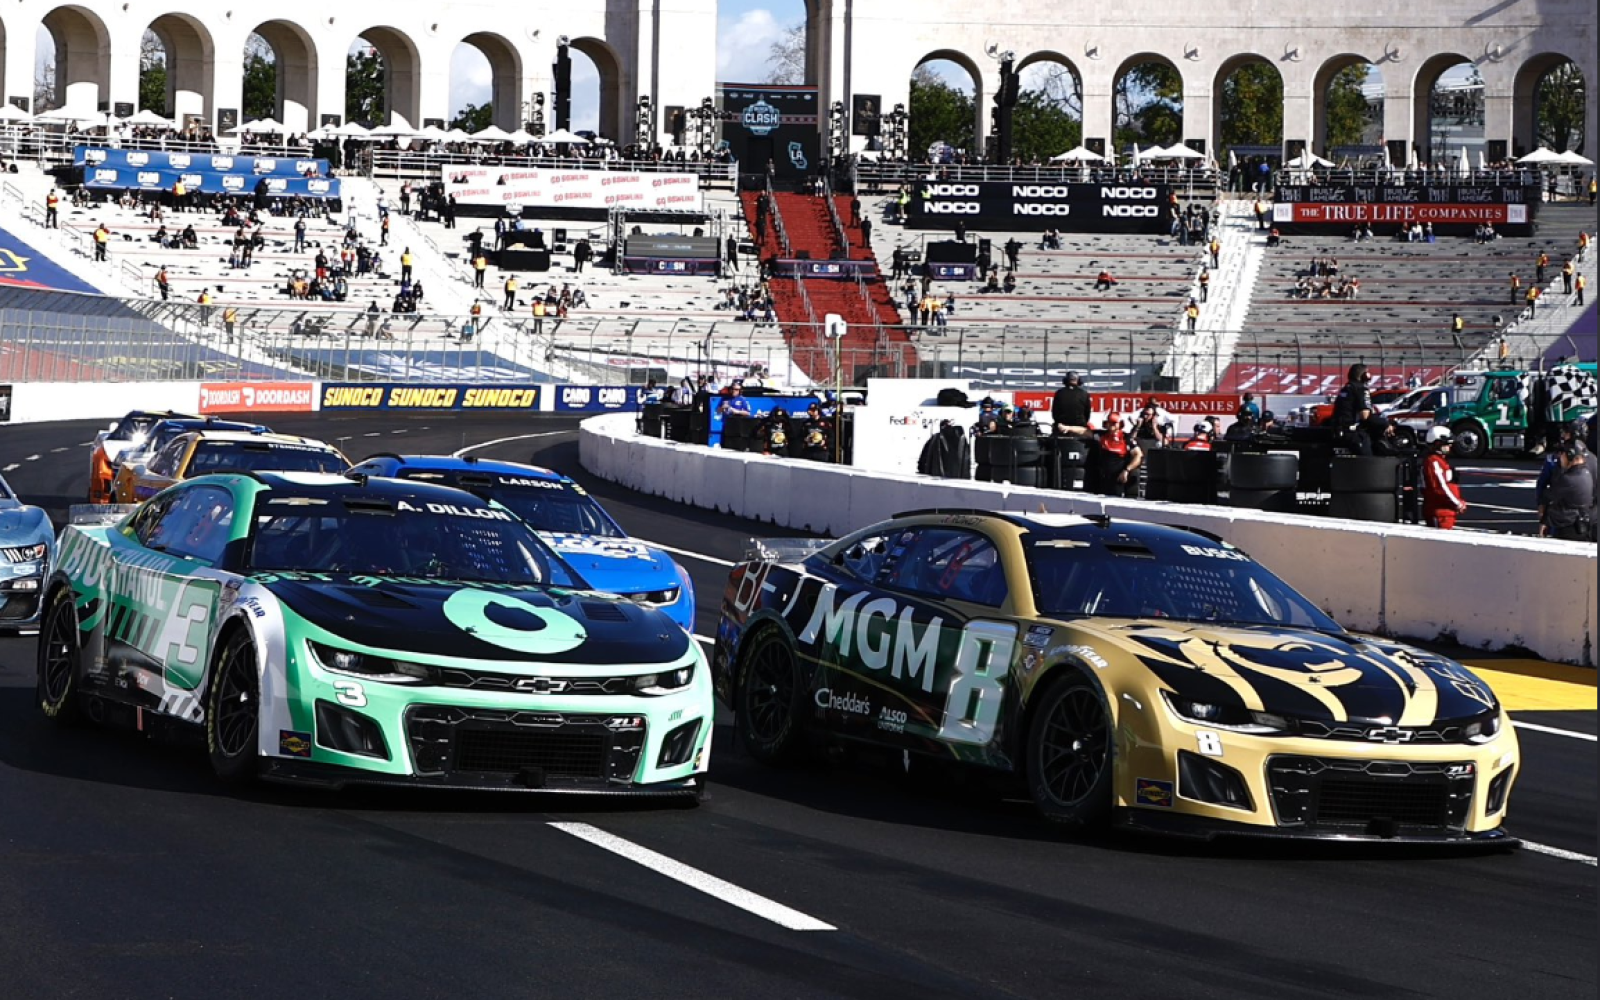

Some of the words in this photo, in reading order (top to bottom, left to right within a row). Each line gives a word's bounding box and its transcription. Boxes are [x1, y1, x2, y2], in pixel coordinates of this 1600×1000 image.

[745, 113, 777, 124] CLASH
[927, 185, 980, 197] NOCO
[1012, 185, 1069, 198] NOCO
[1101, 187, 1157, 199] NOCO
[924, 202, 980, 214] NOCO
[1013, 203, 1070, 216] NOCO
[1103, 205, 1159, 217] NOCO
[1300, 208, 1319, 217] THE
[1321, 204, 1367, 220] TRUE
[1373, 205, 1415, 220] LIFE
[1419, 208, 1502, 218] COMPANIES
[952, 366, 1136, 377] NOCO
[256, 389, 310, 405] DOORDASH
[323, 387, 383, 406] SUNOCO
[387, 389, 457, 407] SUNOCO
[462, 389, 536, 407] SUNOCO
[1023, 400, 1043, 409] THE
[1100, 397, 1143, 412] LIFE
[1157, 400, 1234, 412] OMPANIES
[499, 476, 564, 490] LARSON
[397, 500, 423, 512] A.
[426, 503, 512, 522] DILLON
[1180, 544, 1250, 563] BUSCH
[165, 579, 222, 690] 3
[798, 583, 944, 693] MGM
[937, 619, 1019, 745] 8
[333, 679, 368, 707] 3
[814, 687, 870, 716] Cheddar's
[1195, 730, 1224, 757] 8
